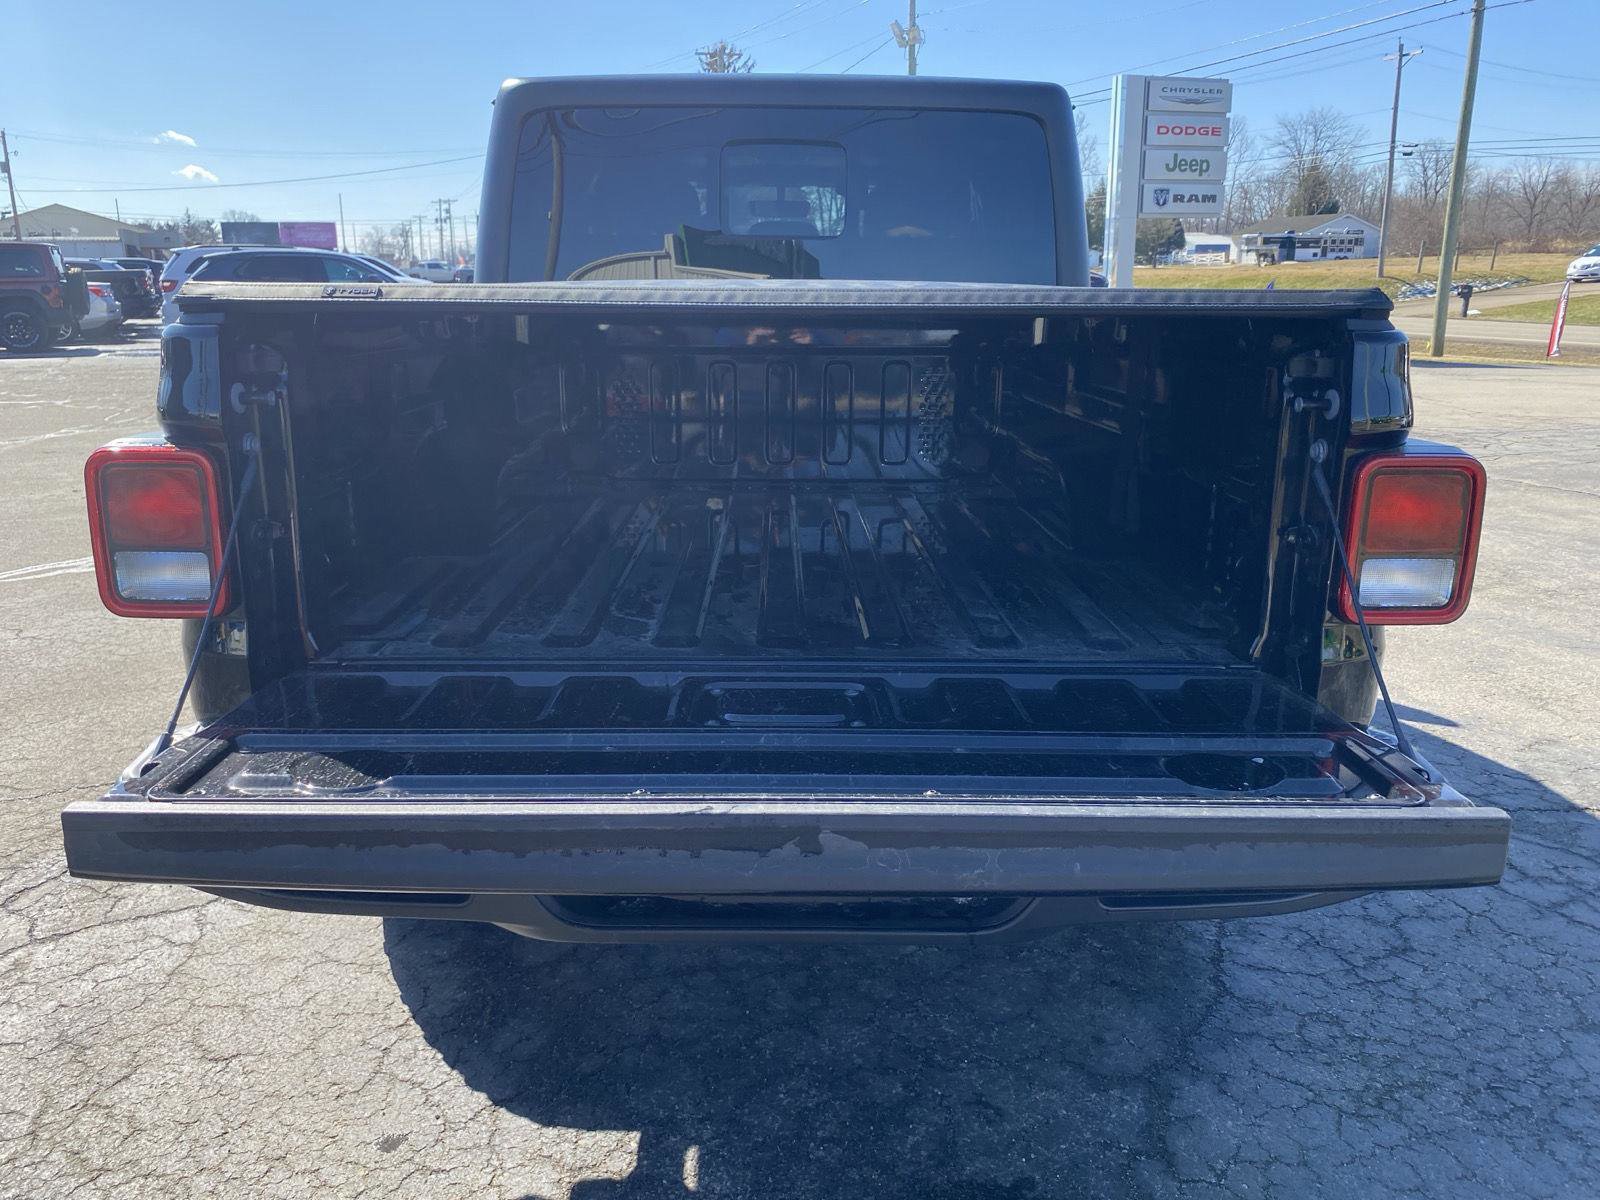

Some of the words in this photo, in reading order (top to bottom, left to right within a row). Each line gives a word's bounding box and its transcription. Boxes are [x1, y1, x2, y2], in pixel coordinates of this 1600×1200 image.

[1162, 86, 1223, 95] CHRYSLER
[1156, 125, 1222, 136] DODGE
[1165, 153, 1210, 176] Jeep
[1172, 193, 1217, 203] RAM
